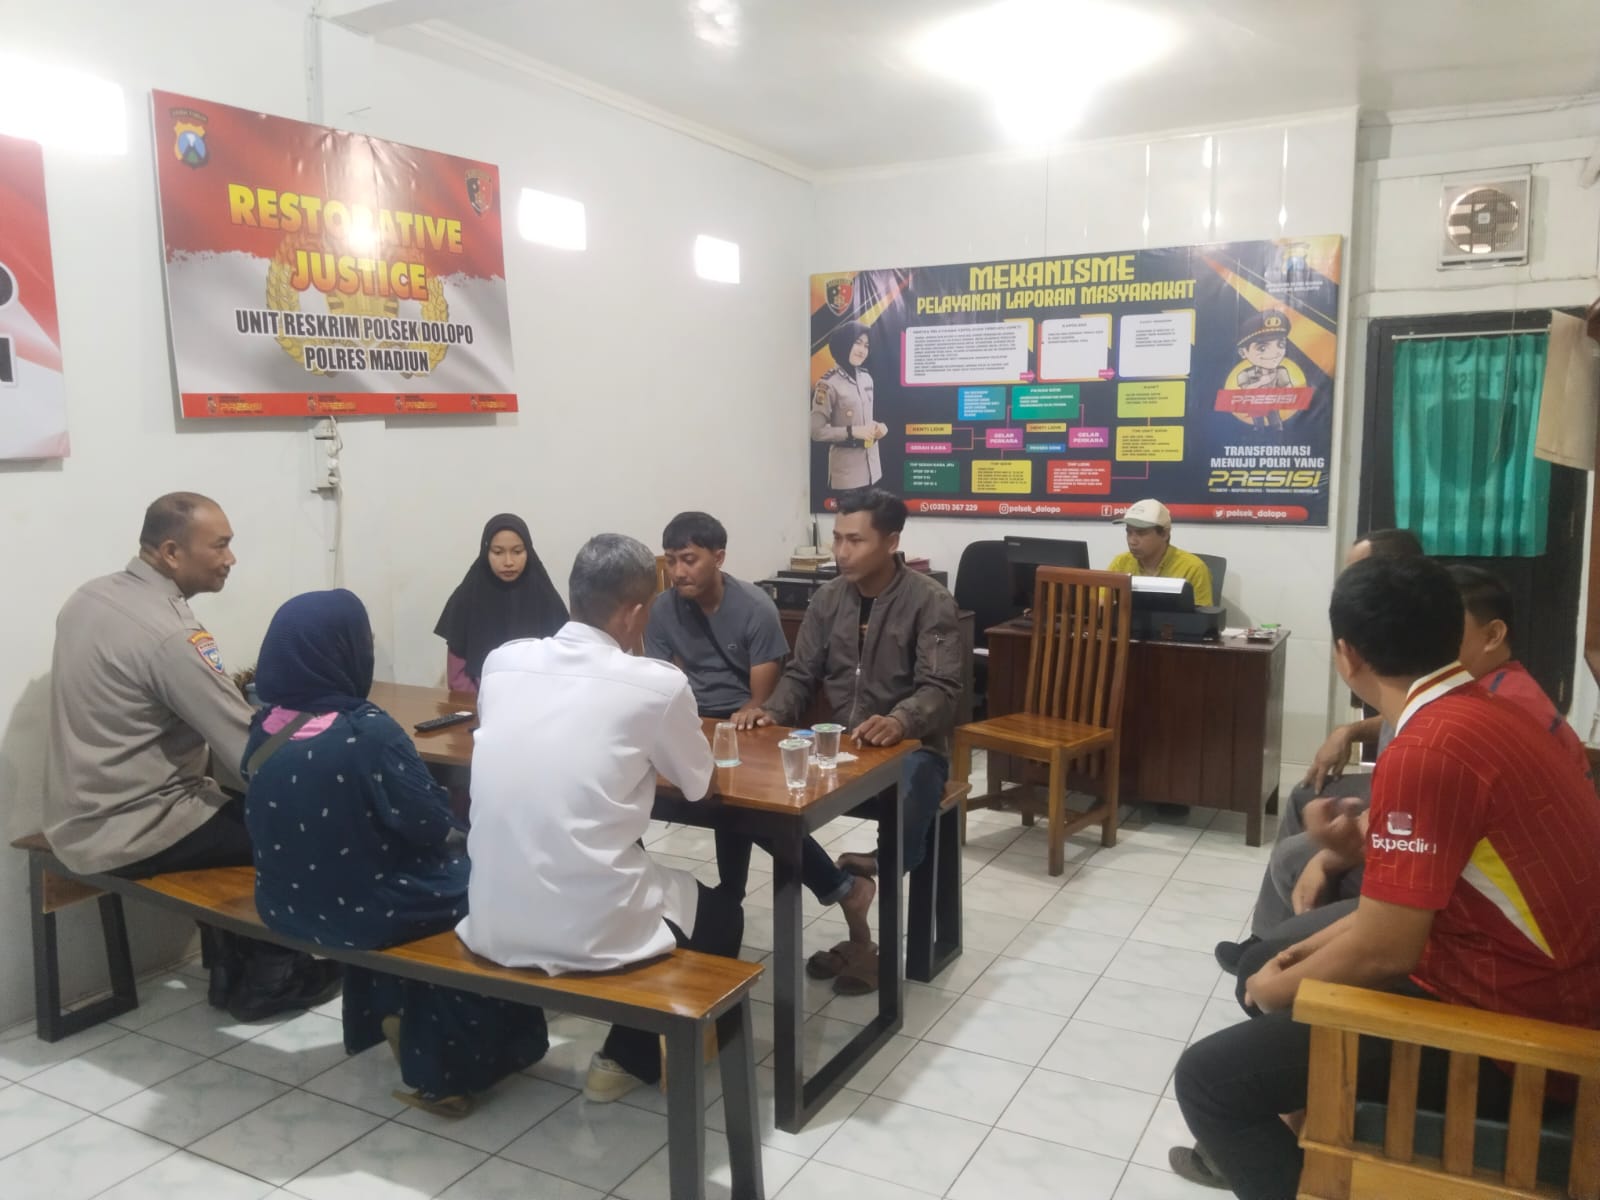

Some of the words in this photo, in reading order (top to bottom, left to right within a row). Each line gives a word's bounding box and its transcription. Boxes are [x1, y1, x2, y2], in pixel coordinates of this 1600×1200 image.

[291, 250, 429, 301] JUSTICE
[969, 255, 1136, 291] MEKANISME
[917, 292, 1001, 315] PELAYANAN
[1006, 287, 1076, 309] LAPORAN
[1081, 280, 1197, 305] MASYARAKAT
[235, 310, 279, 335] UNIT
[283, 313, 360, 338] RESKRIM
[364, 318, 419, 342] POLSEK
[421, 324, 474, 344] DOLOPO
[305, 347, 366, 371] POLRES
[370, 350, 429, 372] MADIUN
[1231, 394, 1298, 405] PRESISI
[1224, 445, 1311, 457] TRANSFORMASI
[1210, 457, 1256, 468] MENUJU
[1259, 457, 1291, 468] POLRI
[1294, 457, 1325, 468] YANG
[1208, 470, 1322, 487] PRESISI
[929, 503, 951, 512] (0351)
[952, 503, 964, 511] 367
[965, 503, 978, 512] 229
[1009, 504, 1061, 514] polsek_dolopo
[1226, 508, 1287, 519] polsek_dolopo
